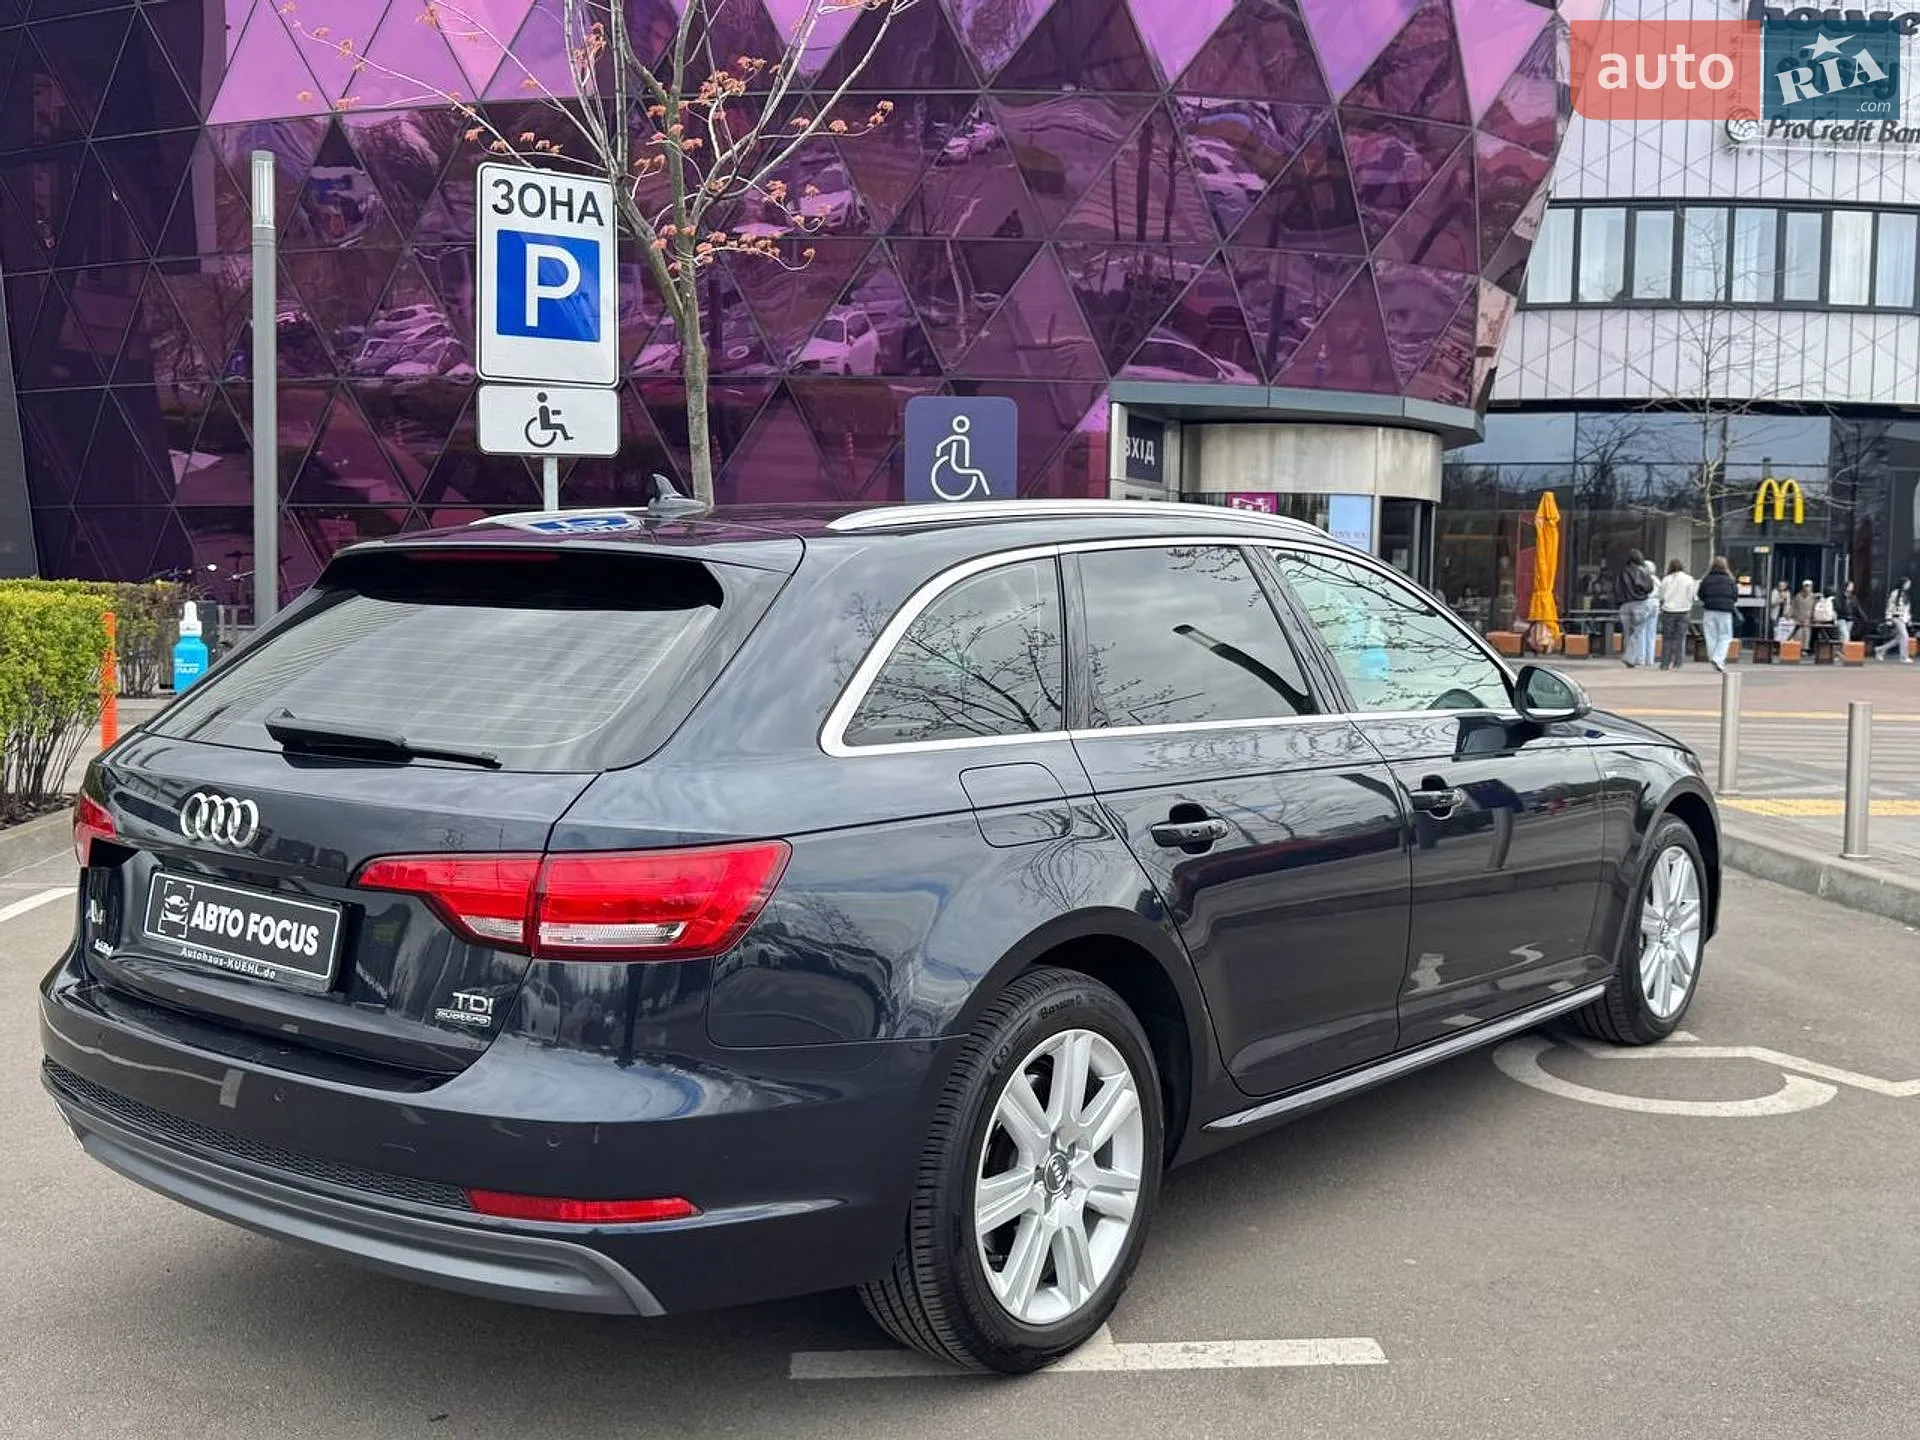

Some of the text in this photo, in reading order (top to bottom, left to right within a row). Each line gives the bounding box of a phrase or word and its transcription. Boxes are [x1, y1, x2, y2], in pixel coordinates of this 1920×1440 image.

[1767, 115, 1875, 142] ProCredit
[491, 178, 604, 227] ЗОНА
[525, 243, 581, 327] P
[190, 901, 320, 956] АВТО FOCUS
[452, 992, 494, 1014] TDI
